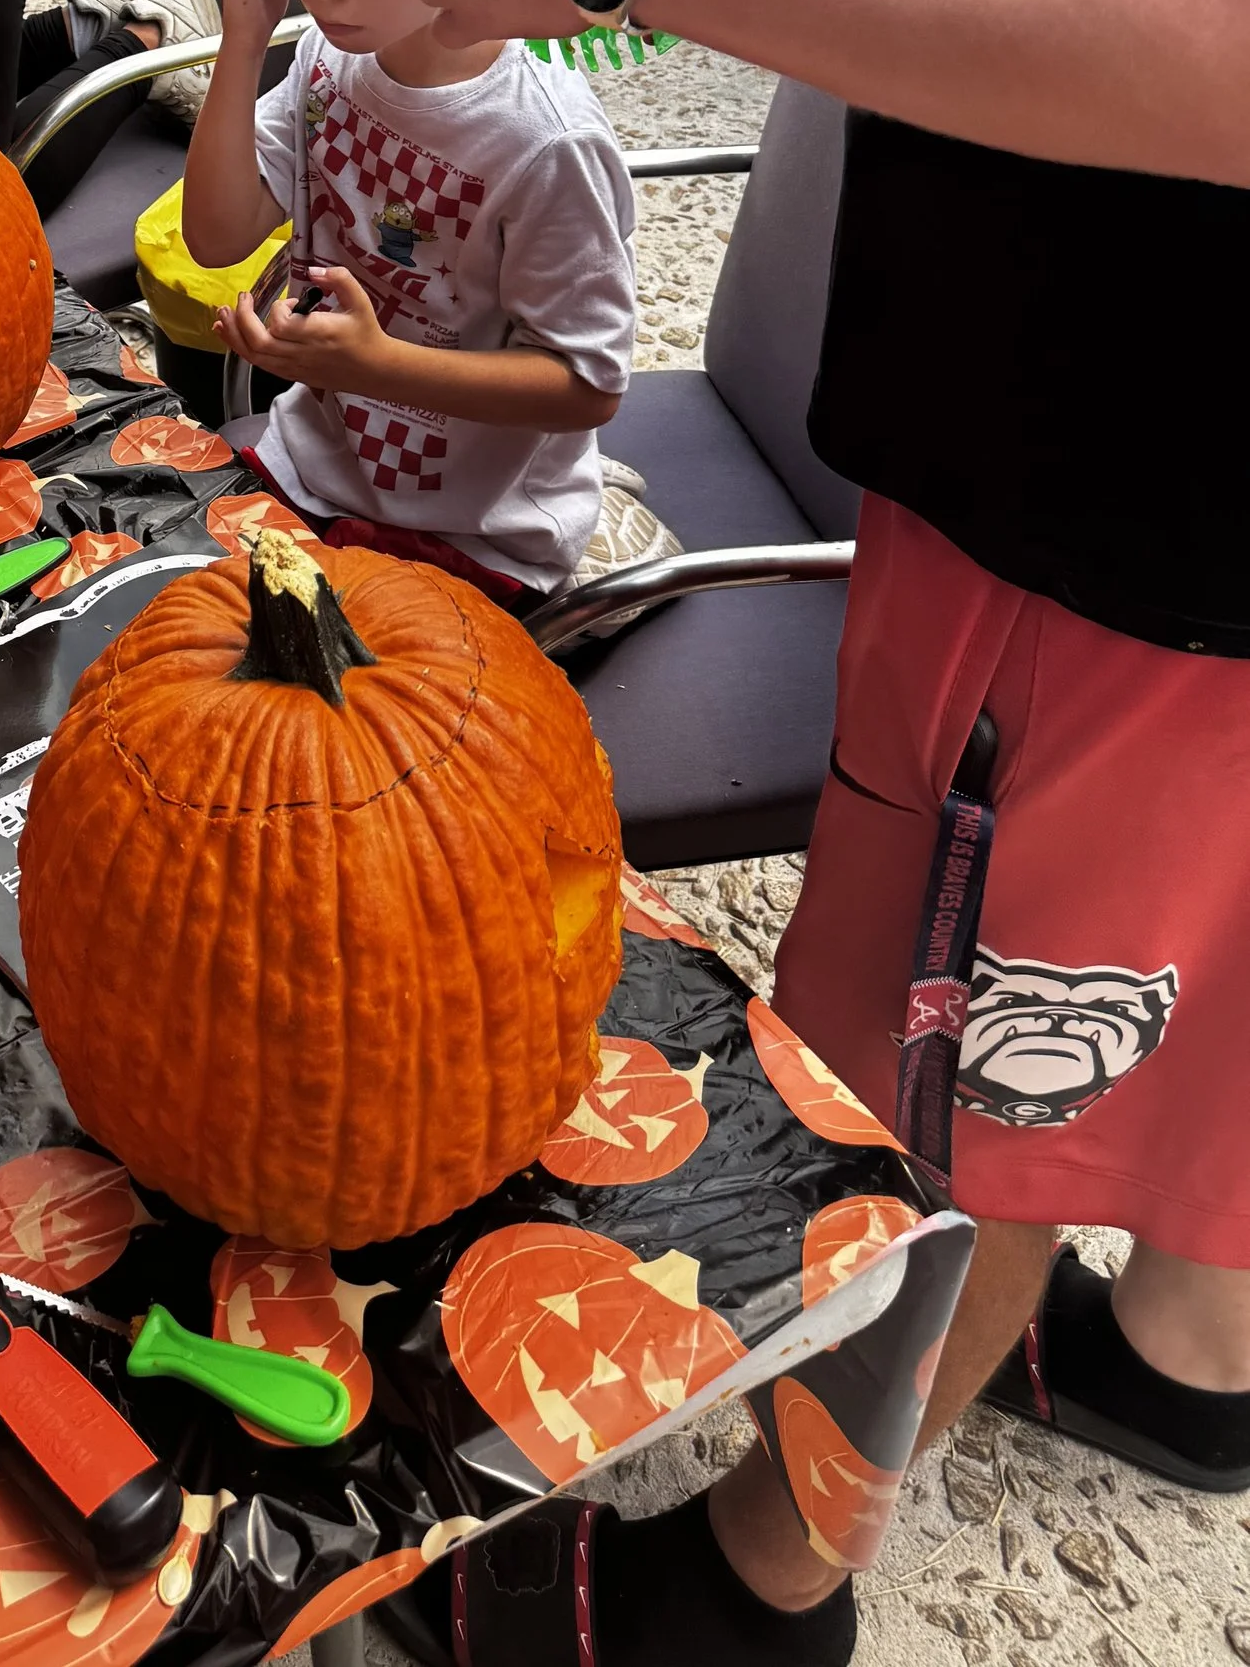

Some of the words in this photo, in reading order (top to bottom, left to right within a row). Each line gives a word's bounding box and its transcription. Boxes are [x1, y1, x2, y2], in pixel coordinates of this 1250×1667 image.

[402, 137, 441, 165] FUELING
[443, 158, 485, 184] STATION
[953, 803, 982, 841] THIS
[950, 840, 976, 857] IS
[937, 856, 972, 909] BRAVES
[925, 911, 959, 971] COUNTRY
